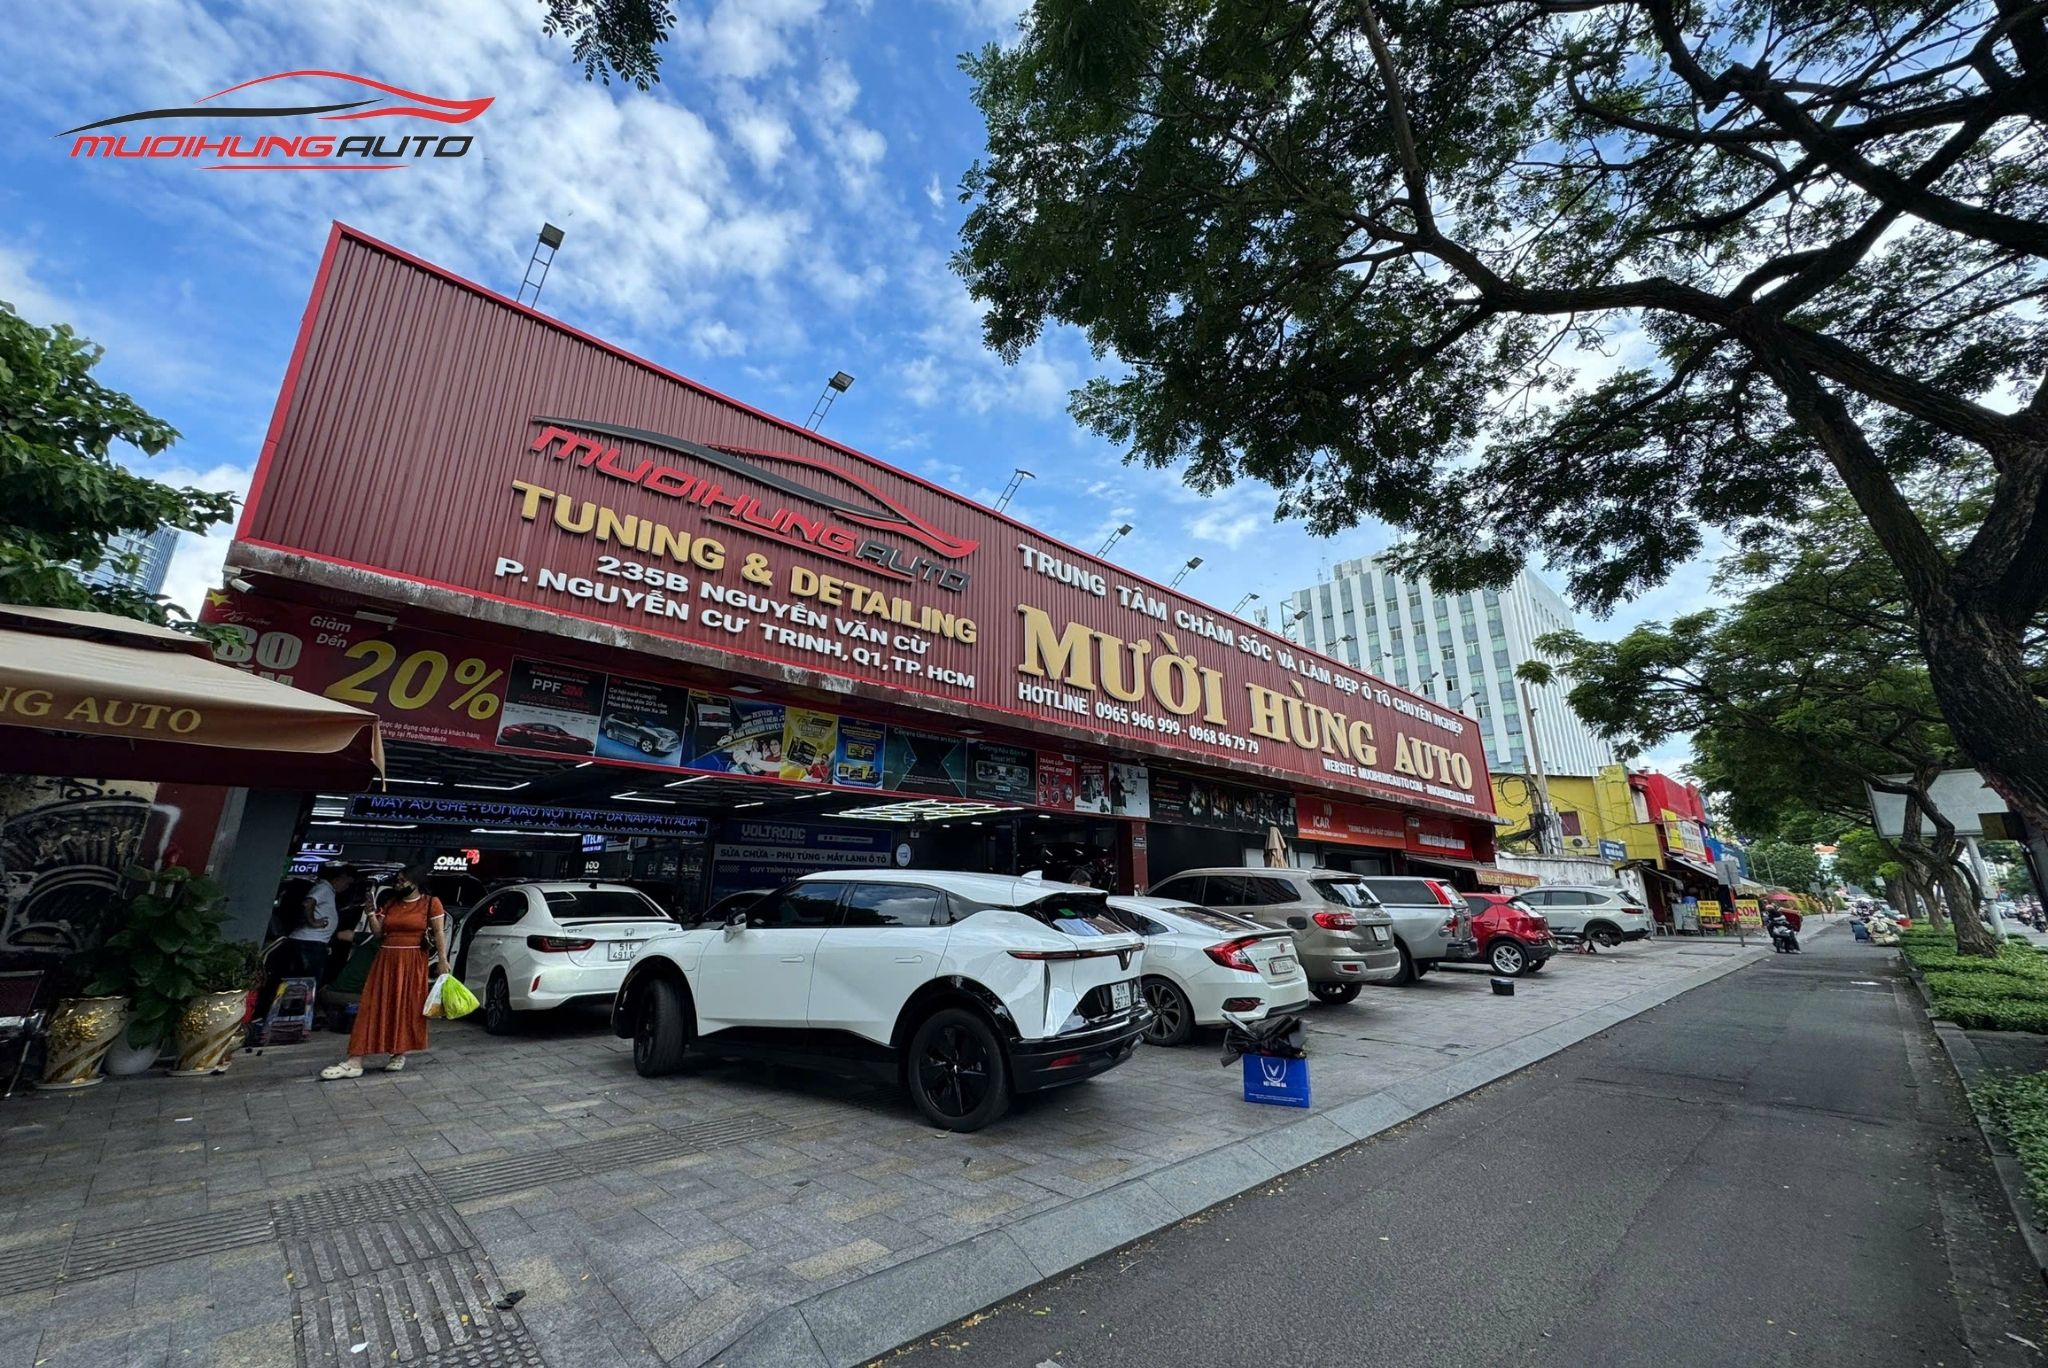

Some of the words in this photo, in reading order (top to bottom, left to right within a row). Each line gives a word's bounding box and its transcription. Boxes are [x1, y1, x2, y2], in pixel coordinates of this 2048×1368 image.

[512, 480, 725, 571] TUNING
[741, 552, 773, 587] &
[790, 566, 977, 643] DETAILING
[310, 615, 351, 634] Giảm
[494, 556, 529, 583] P.
[537, 567, 689, 621] NGUYỄN
[700, 609, 750, 633] CƯ
[760, 622, 849, 662] TRINH,
[852, 647, 888, 671] Q1,
[890, 655, 923, 677] TP.
[927, 664, 975, 689] HCM
[597, 556, 689, 592] 235B
[700, 581, 827, 629] NGUYỄN
[834, 617, 887, 646] VĂN
[893, 633, 931, 655] CỪ
[316, 632, 347, 649] Đến
[1018, 543, 1106, 596] TRUNG
[1116, 585, 1167, 621] TÂM
[1175, 609, 1234, 646] CHĂM
[1238, 634, 1272, 661] SÓC
[1277, 649, 1298, 672] VÀ
[1300, 659, 1331, 685] LÀM
[1333, 674, 1359, 697] ĐẸP
[1361, 682, 1372, 700] Ô
[1374, 689, 1391, 708] TÔ
[1392, 697, 1432, 723] CHUYÊN
[1432, 713, 1464, 736] NGHIỆP
[325, 639, 500, 721] 20%
[532, 678, 562, 693] PPF
[1017, 603, 1227, 727] MƯỜI
[1246, 679, 1378, 767] HÙNG
[1393, 731, 1473, 790] AUTO
[64, 695, 202, 734] AUTO
[1095, 702, 1128, 724] 0965
[1131, 710, 1154, 730] 966
[1157, 716, 1180, 736] 999
[1188, 725, 1216, 744] 0968
[741, 824, 806, 841] VOLTRONIC
[434, 856, 468, 866] OBAL
